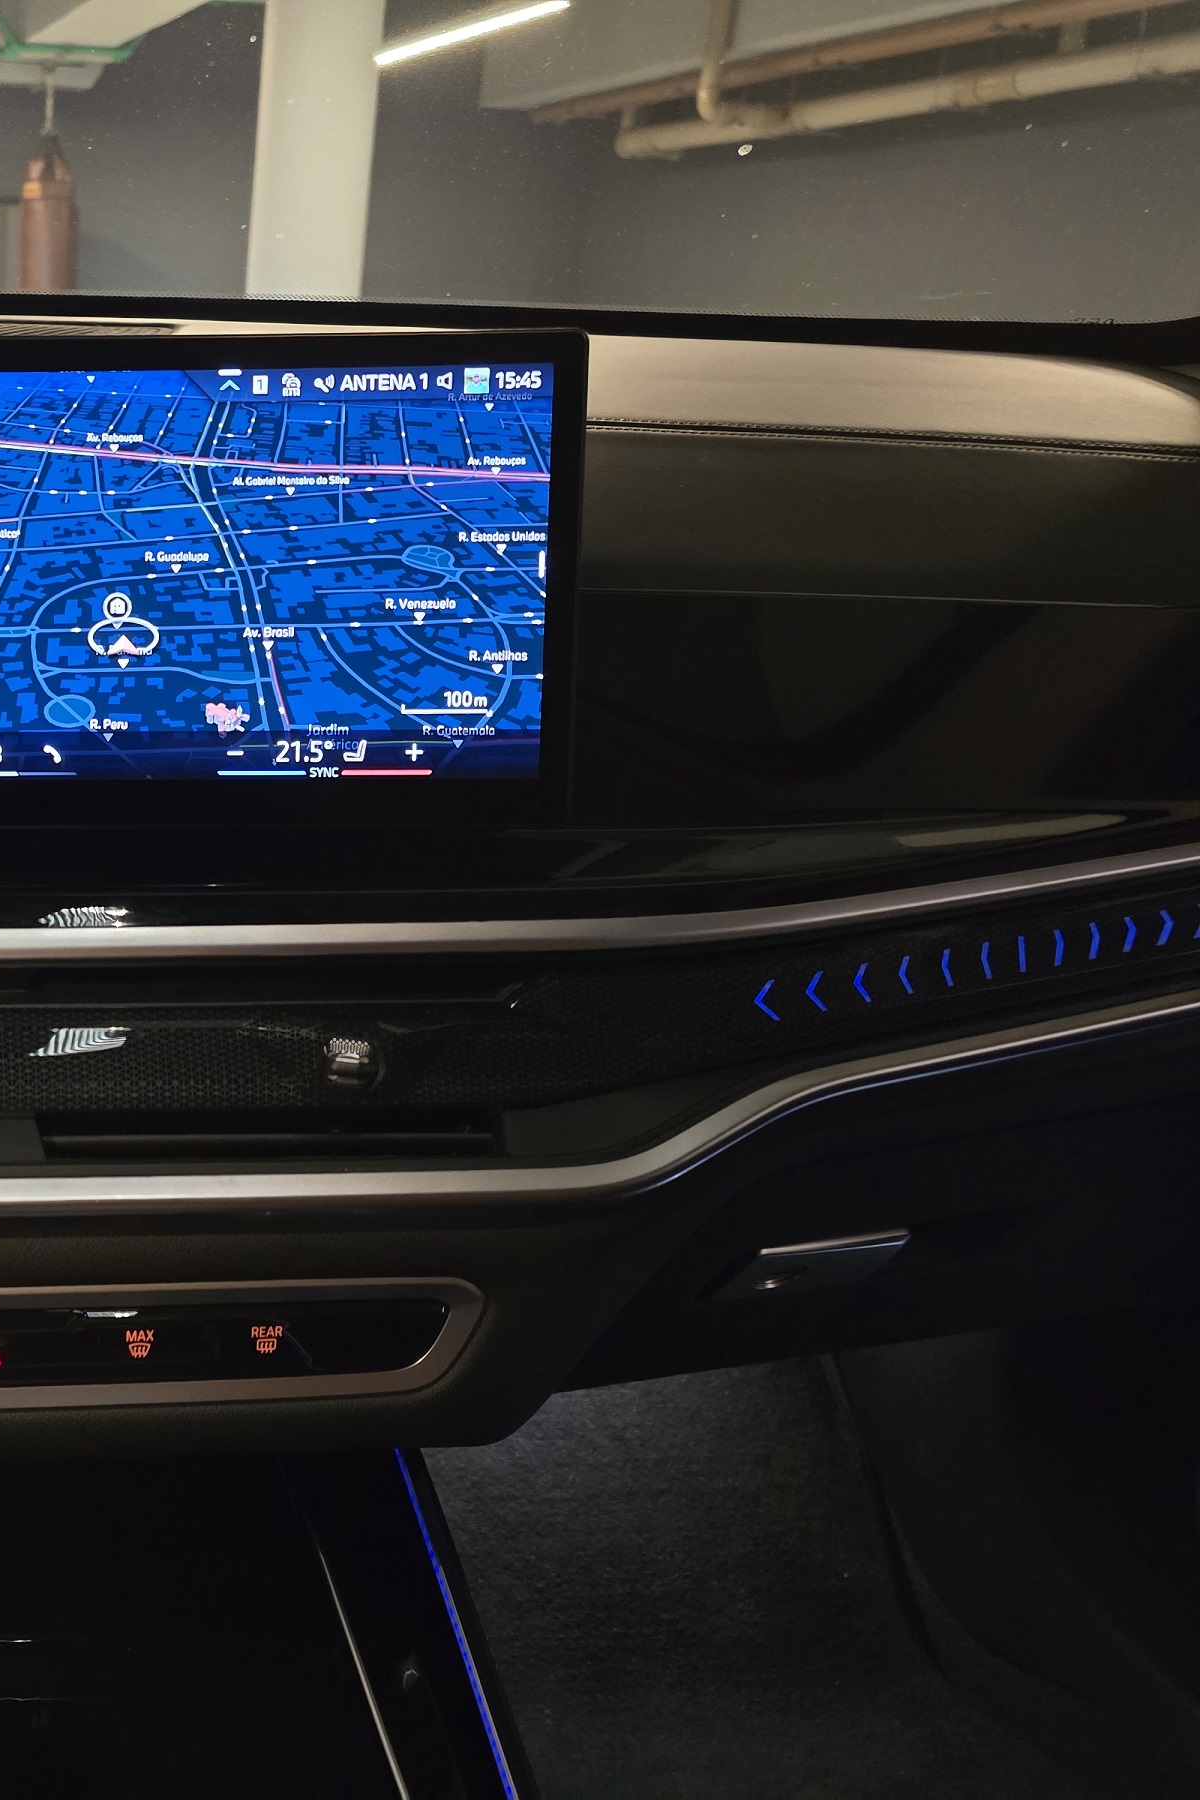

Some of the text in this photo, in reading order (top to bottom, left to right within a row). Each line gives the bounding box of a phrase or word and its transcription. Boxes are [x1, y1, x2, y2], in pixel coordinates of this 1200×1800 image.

[340, 372, 429, 392] ANTENA 1
[495, 370, 543, 390] 15:45
[448, 392, 457, 402] R.
[495, 391, 533, 401] Azevedo
[101, 432, 144, 444] Rebouças
[467, 455, 526, 467] Av. Rebouças
[245, 476, 276, 486] Gabriel
[276, 475, 316, 486] Monteiro
[316, 475, 328, 485] da
[328, 475, 350, 485] Silva
[458, 530, 546, 543] R. Estados Unidos
[144, 550, 210, 564] R. Guadelupe
[384, 597, 457, 611] R. Venezuela
[242, 625, 295, 639] Av. Brasil
[468, 649, 528, 663] R. Antilhas
[89, 718, 128, 731] R. Peru
[306, 723, 350, 737] Jardim
[422, 724, 496, 738] R. Guatemala
[275, 740, 334, 763] 21.5°
[308, 766, 340, 778] SYNC
[125, 1329, 155, 1342] MAX
[251, 1325, 283, 1338] REAR
